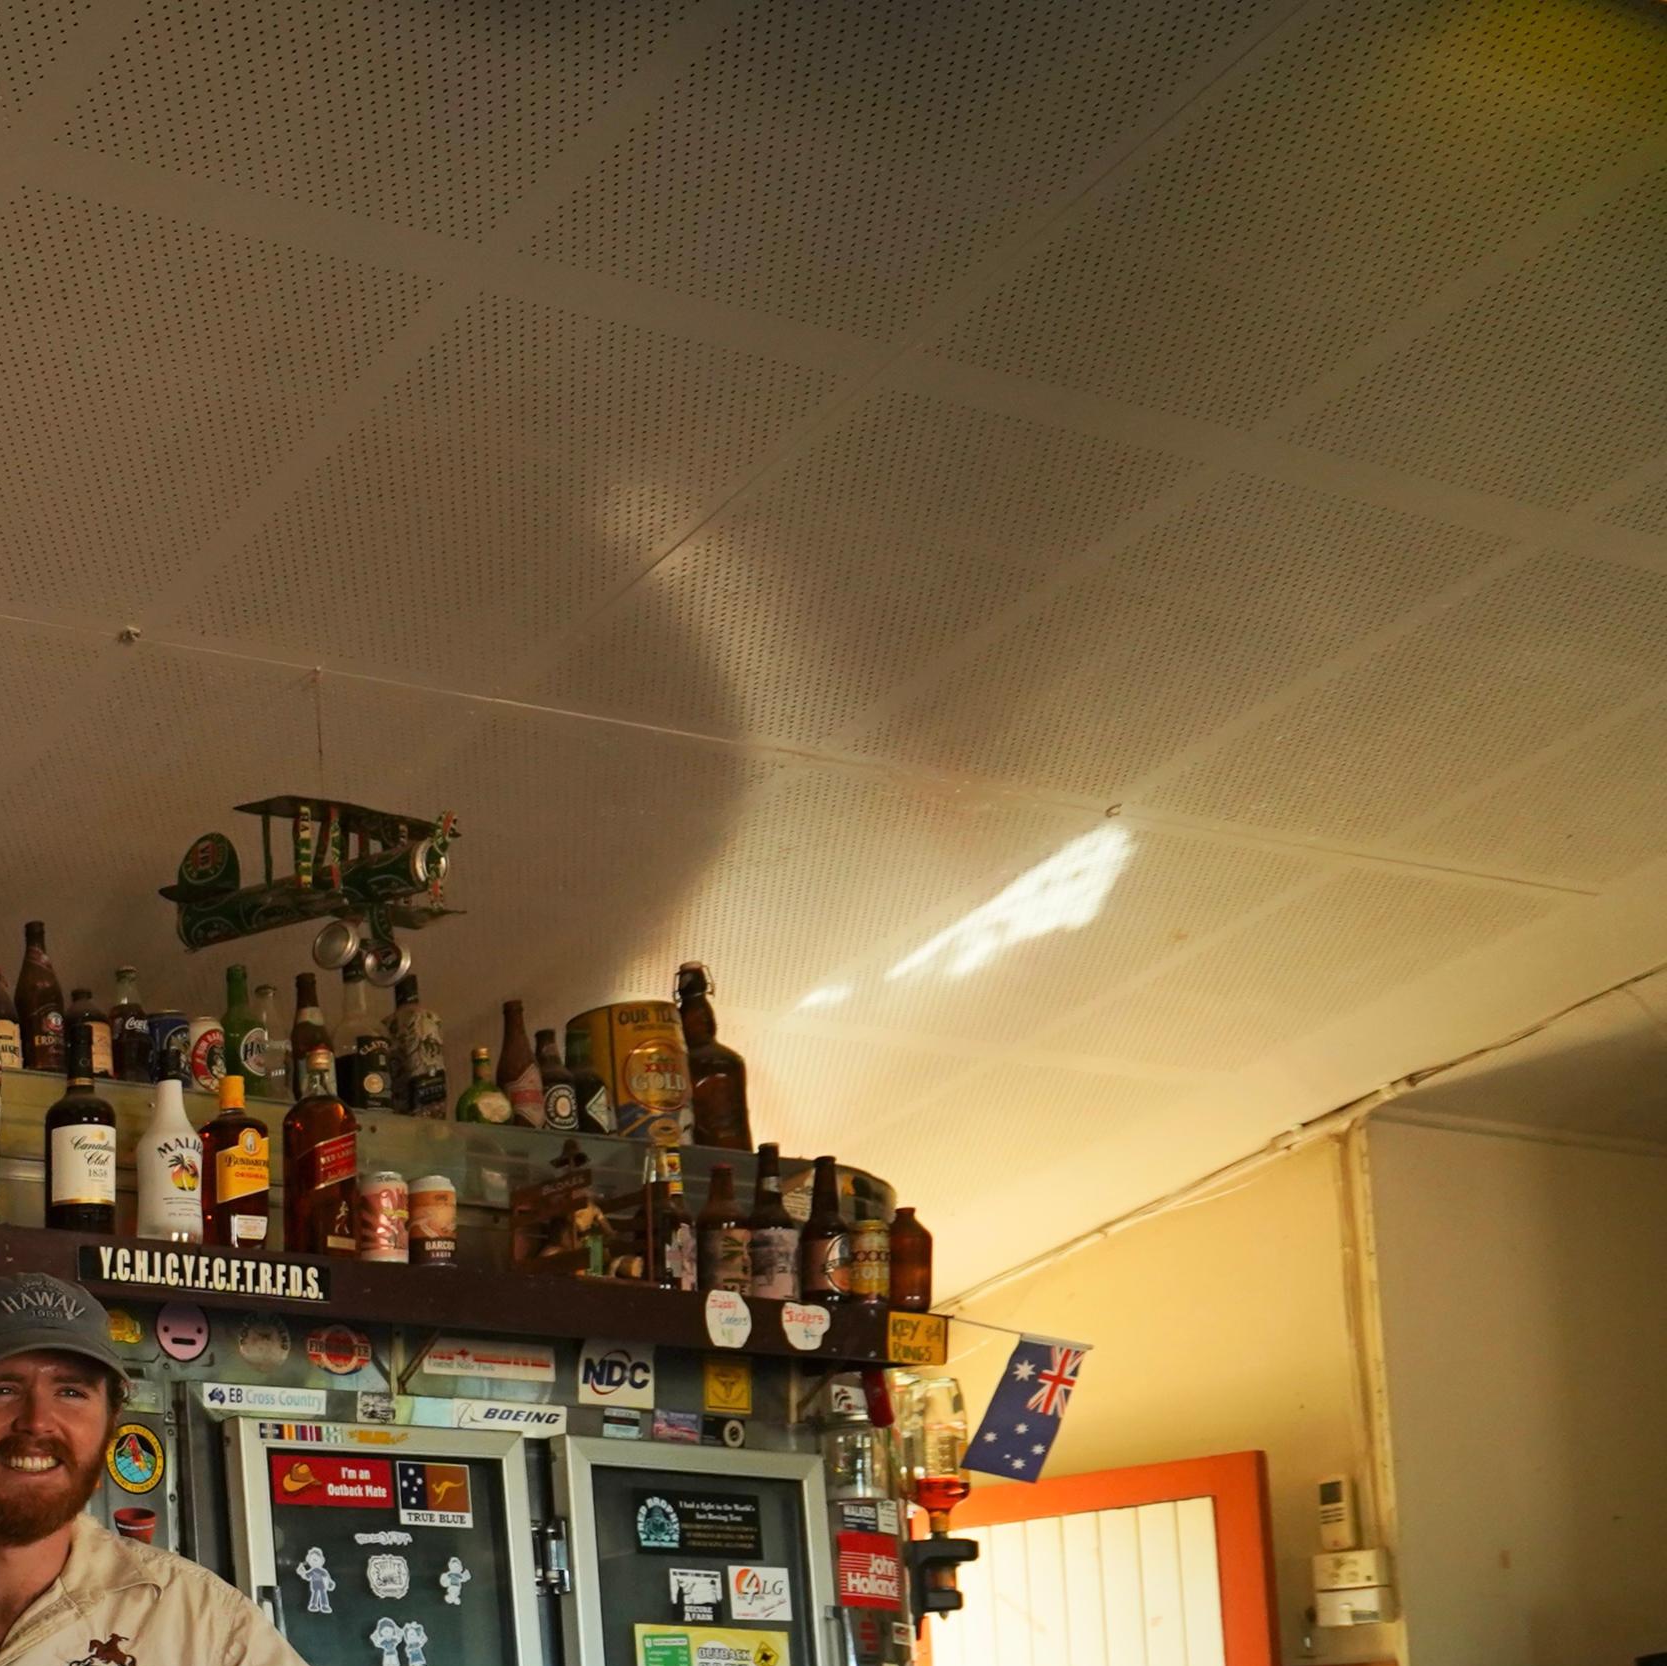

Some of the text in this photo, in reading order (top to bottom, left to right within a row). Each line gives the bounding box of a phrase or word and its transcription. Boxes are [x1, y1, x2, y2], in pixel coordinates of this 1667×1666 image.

[617, 1008, 650, 1025] OUR
[631, 1073, 686, 1092] GOLD
[99, 1245, 324, 1300] Y.C.H.J.C.Y.F.C.F.T.R.F.D.S.
[891, 1319, 918, 1340] KEY
[892, 1342, 933, 1362] RINGS
[581, 1357, 651, 1389] NDC
[228, 1387, 323, 1409] EB Cross Country
[482, 1407, 561, 1425] BOEING
[340, 1466, 371, 1480] I'm an
[326, 1482, 388, 1498] Outback Mate
[684, 1501, 733, 1511] had fight the
[406, 1512, 467, 1525] TRUE BLUE
[706, 1513, 729, 1523] Boxing
[868, 1553, 897, 1577] John
[846, 1572, 899, 1599] Holland
[697, 1646, 752, 1662] OUTBACK
